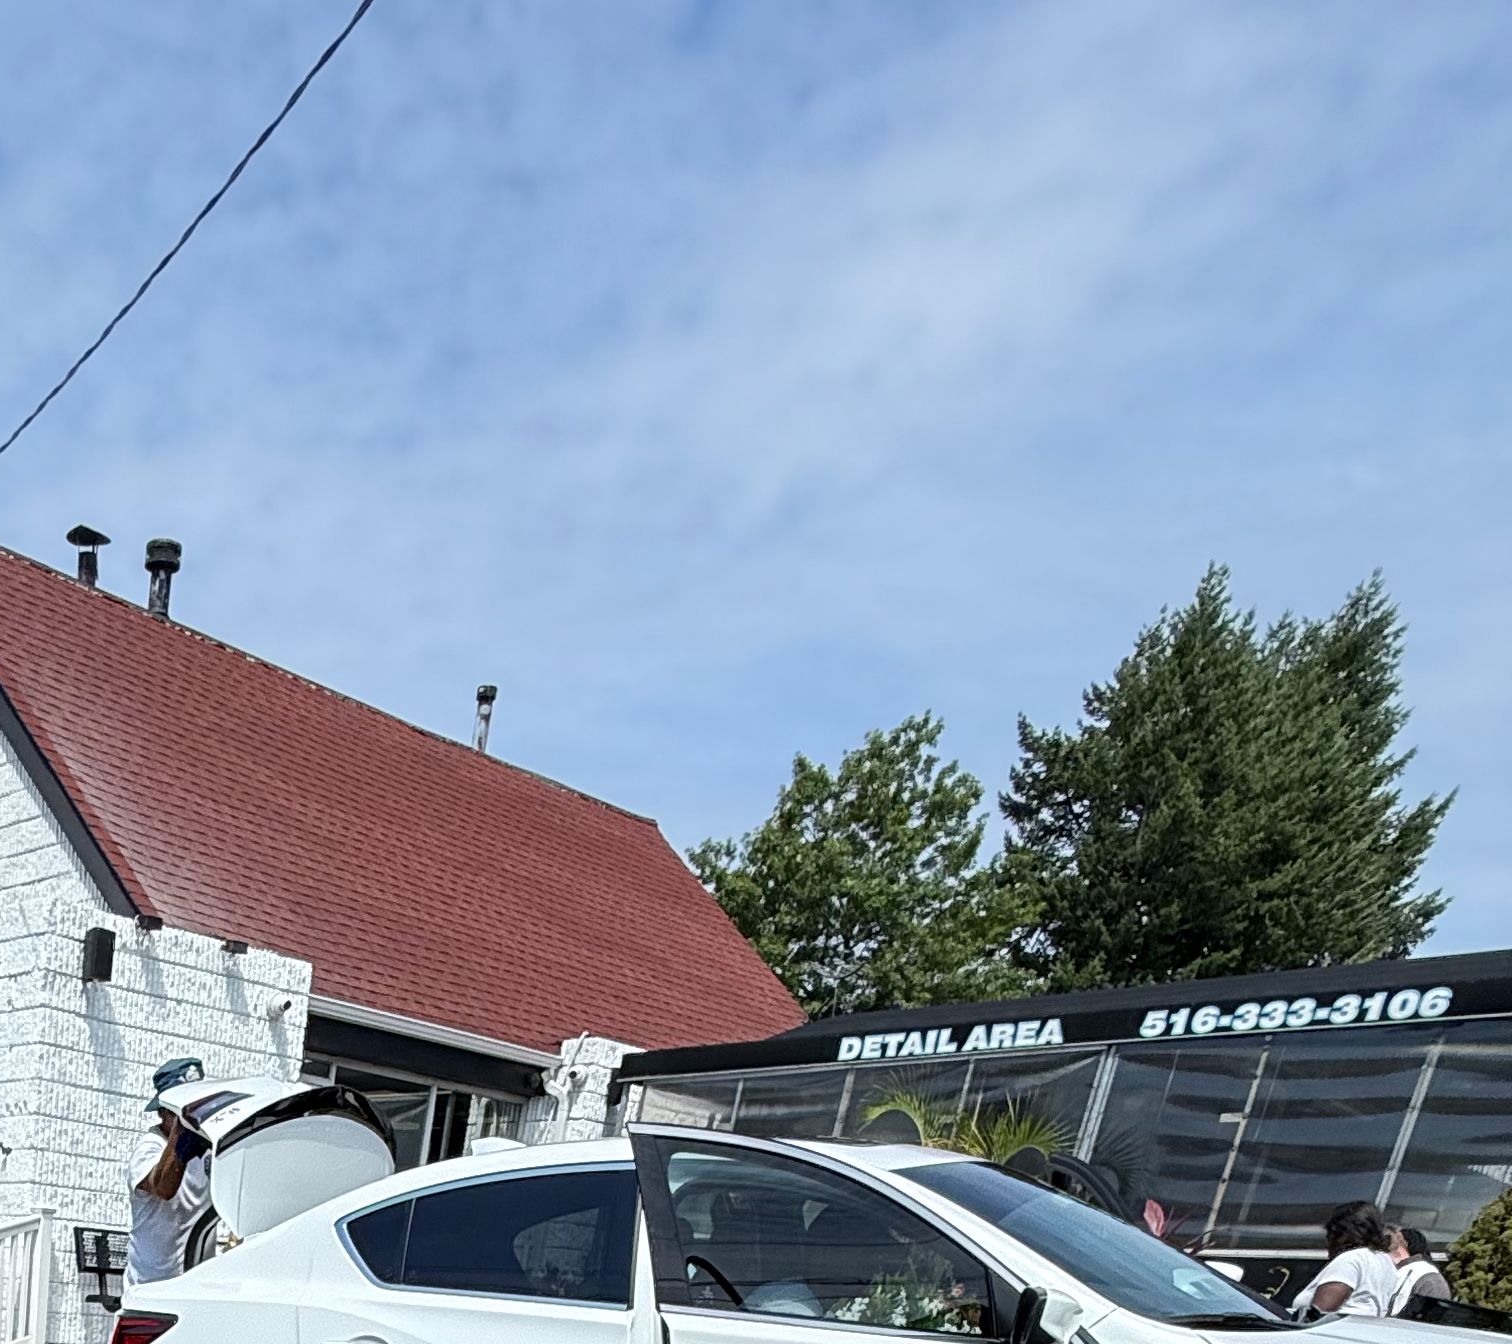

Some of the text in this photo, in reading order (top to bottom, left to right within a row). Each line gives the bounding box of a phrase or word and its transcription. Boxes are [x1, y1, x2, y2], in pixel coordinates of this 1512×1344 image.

[1138, 986, 1454, 1038] 516-333-3106
[836, 1018, 1064, 1061] DETAIL AREA
